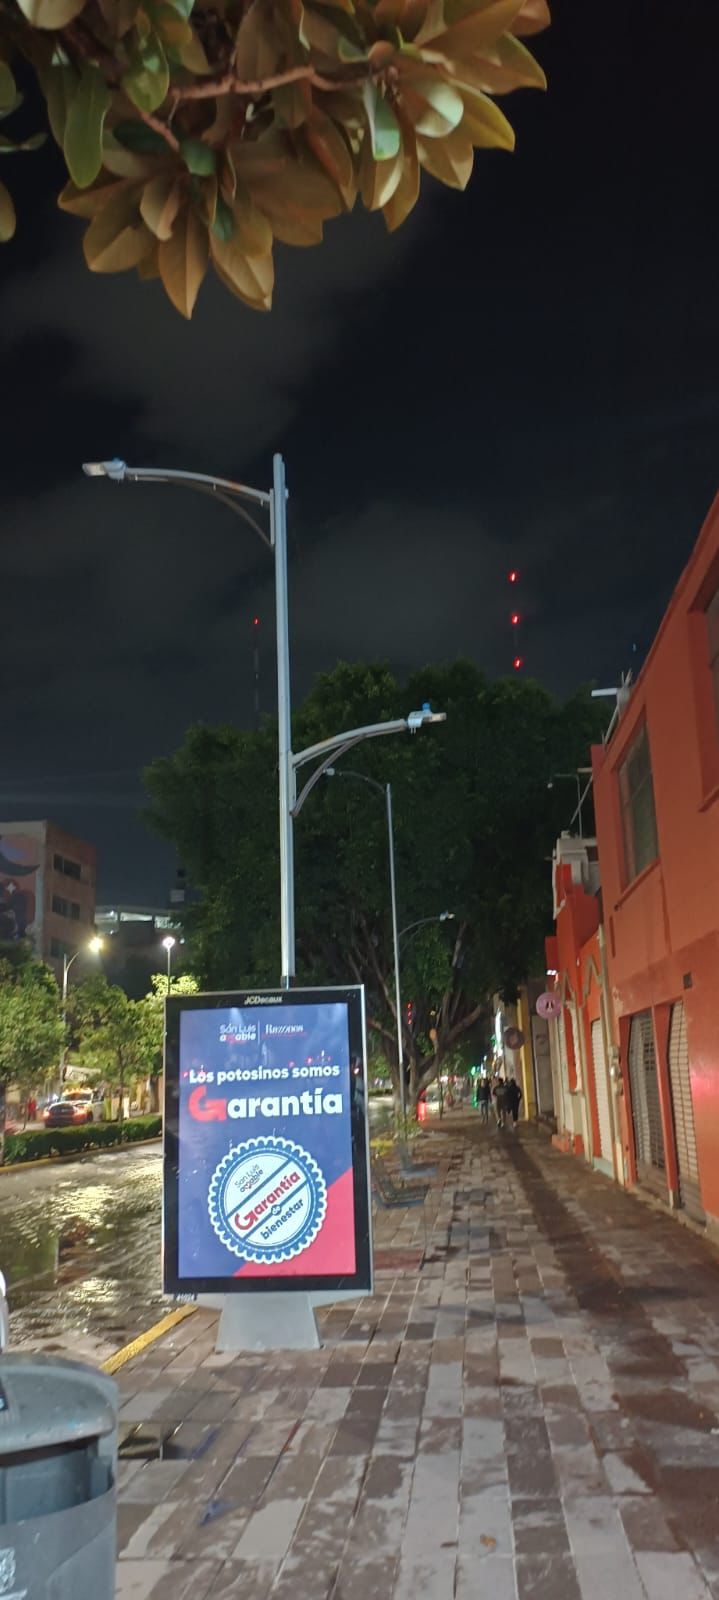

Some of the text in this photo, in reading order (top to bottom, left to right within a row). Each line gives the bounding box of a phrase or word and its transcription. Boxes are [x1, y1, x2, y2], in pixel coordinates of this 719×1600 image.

[244, 995, 283, 1006] JCDecaux
[189, 1064, 340, 1085] Los potosinos somos
[188, 1086, 343, 1123] Garantía
[234, 1175, 248, 1188] San
[260, 1198, 304, 1240] bienestar
